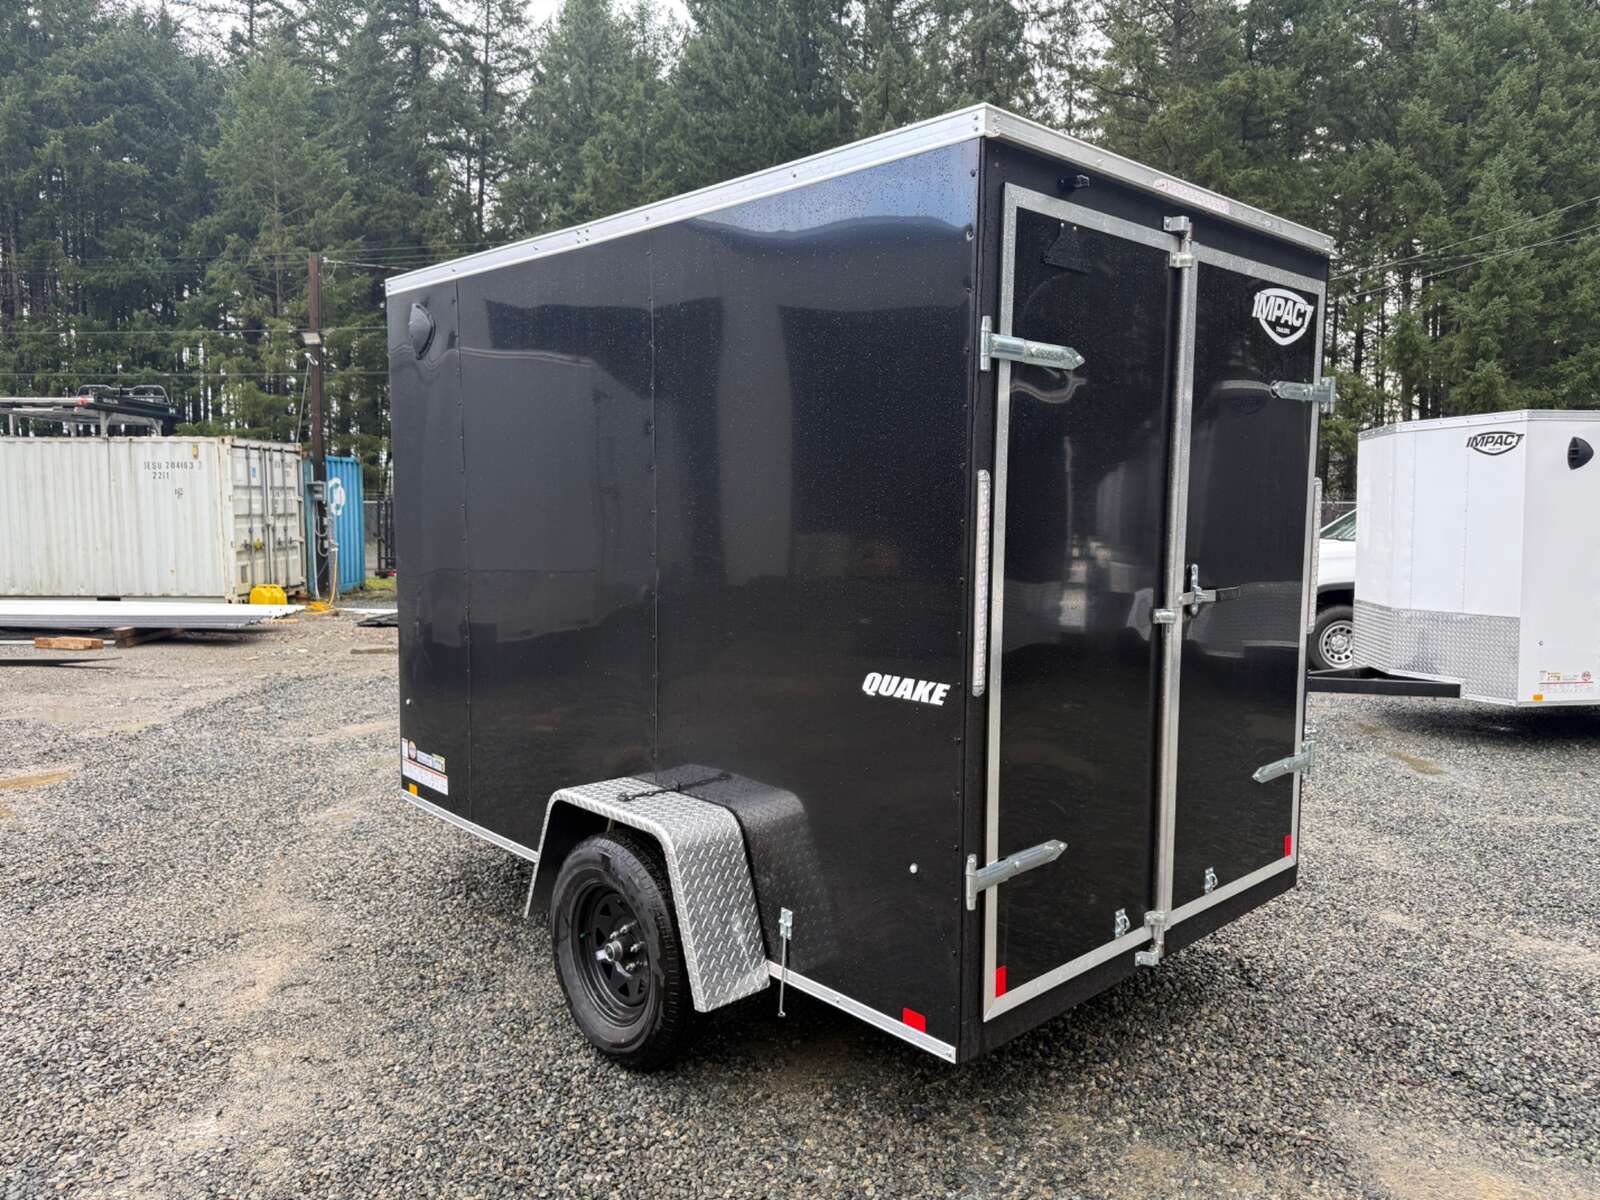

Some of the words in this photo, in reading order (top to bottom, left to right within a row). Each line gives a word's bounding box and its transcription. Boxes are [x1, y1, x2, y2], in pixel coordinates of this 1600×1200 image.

[1251, 292, 1315, 329] IMPACT
[1466, 433, 1525, 448] IMPACT
[862, 672, 951, 706] QUAKE
